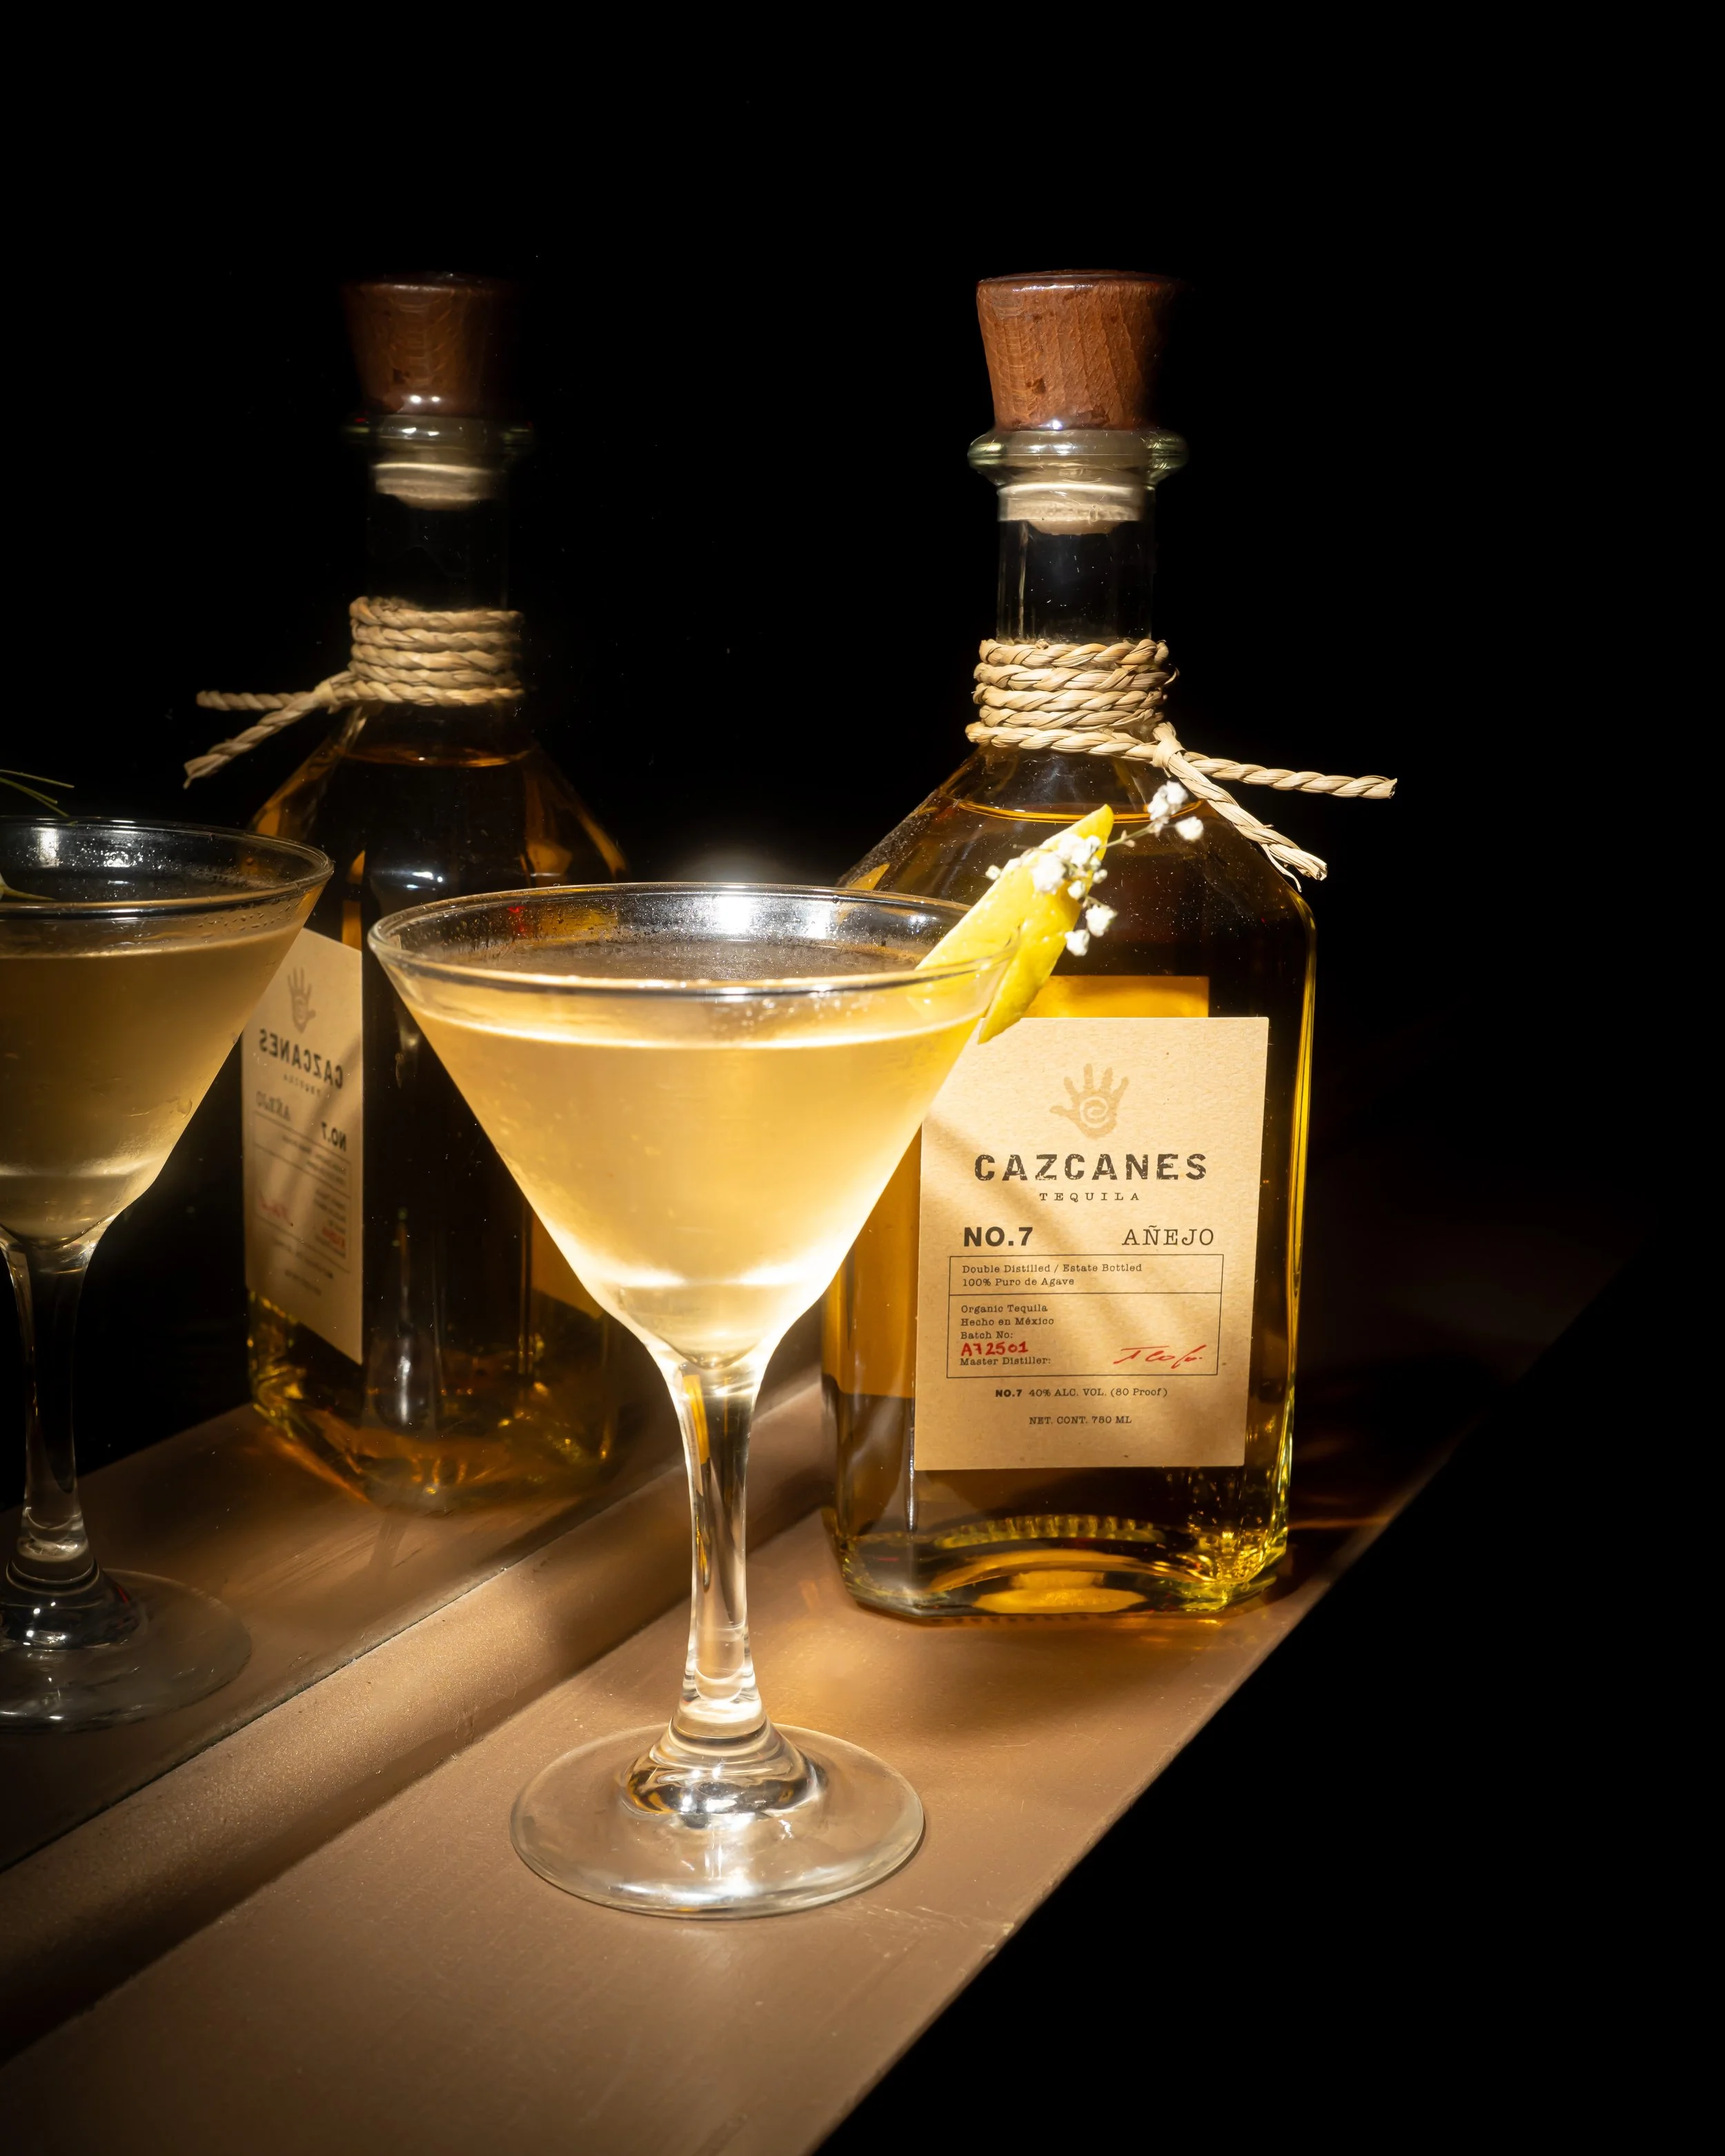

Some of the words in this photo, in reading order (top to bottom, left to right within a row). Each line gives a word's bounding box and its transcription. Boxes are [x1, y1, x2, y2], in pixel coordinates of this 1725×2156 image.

[974, 1153, 1208, 1181] CAZCANES
[1038, 1191, 1140, 1203] TEQUILA
[963, 1226, 1034, 1247] NO.7
[1121, 1225, 1214, 1246] AÑEJO
[962, 1265, 1000, 1274] Double
[1004, 1264, 1051, 1273] Distilled
[1063, 1264, 1098, 1272] Estate
[1101, 1263, 1143, 1272] Bottled
[963, 1278, 992, 1287] 100%
[994, 1278, 1021, 1286] Puro
[1025, 1277, 1037, 1285] de
[1041, 1277, 1075, 1287] Agave
[961, 1305, 1003, 1314] Organic
[1007, 1303, 1048, 1314] Tequila
[960, 1318, 994, 1327] Hecho
[1015, 1316, 1054, 1325] México
[960, 1331, 992, 1340] Batch
[996, 1330, 1014, 1339] No:
[960, 1341, 1029, 1356] A72501
[960, 1356, 998, 1366] Master
[1002, 1356, 1051, 1365] Distiller:
[995, 1388, 1023, 1398] NO.7
[1028, 1388, 1052, 1397] 40%
[1054, 1387, 1078, 1397] ALC.
[1083, 1387, 1107, 1396] VOL.
[1110, 1387, 1130, 1397] (80
[1132, 1387, 1168, 1397] Proof)
[1029, 1416, 1054, 1425] NET.
[1056, 1415, 1088, 1425] CONT.
[1092, 1415, 1112, 1425] 750
[1115, 1415, 1132, 1424] ML
